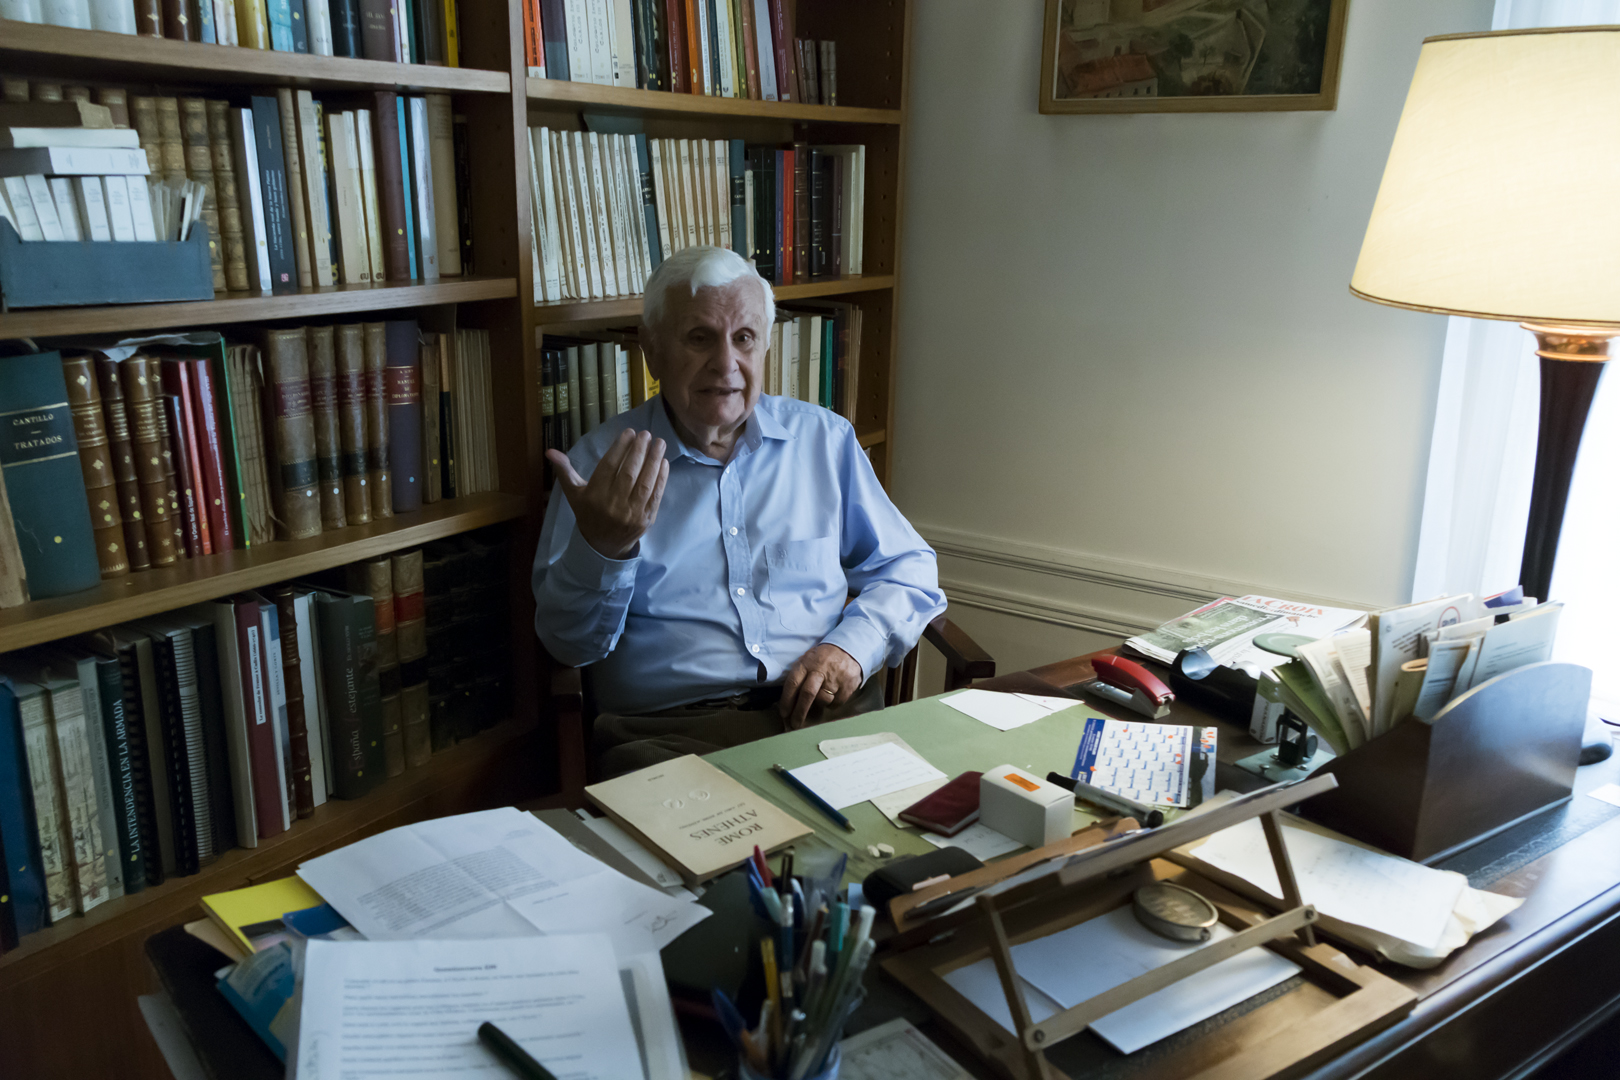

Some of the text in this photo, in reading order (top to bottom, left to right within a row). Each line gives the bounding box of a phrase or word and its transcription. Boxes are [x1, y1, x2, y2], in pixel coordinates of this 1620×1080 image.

[13, 413, 54, 426] CANTILLO
[14, 435, 63, 450] TRATADOS
[112, 698, 140, 853] LA INTENDENCIA EN LA ARMADA
[689, 809, 758, 841] ATHENES
[715, 823, 764, 846] ROME
